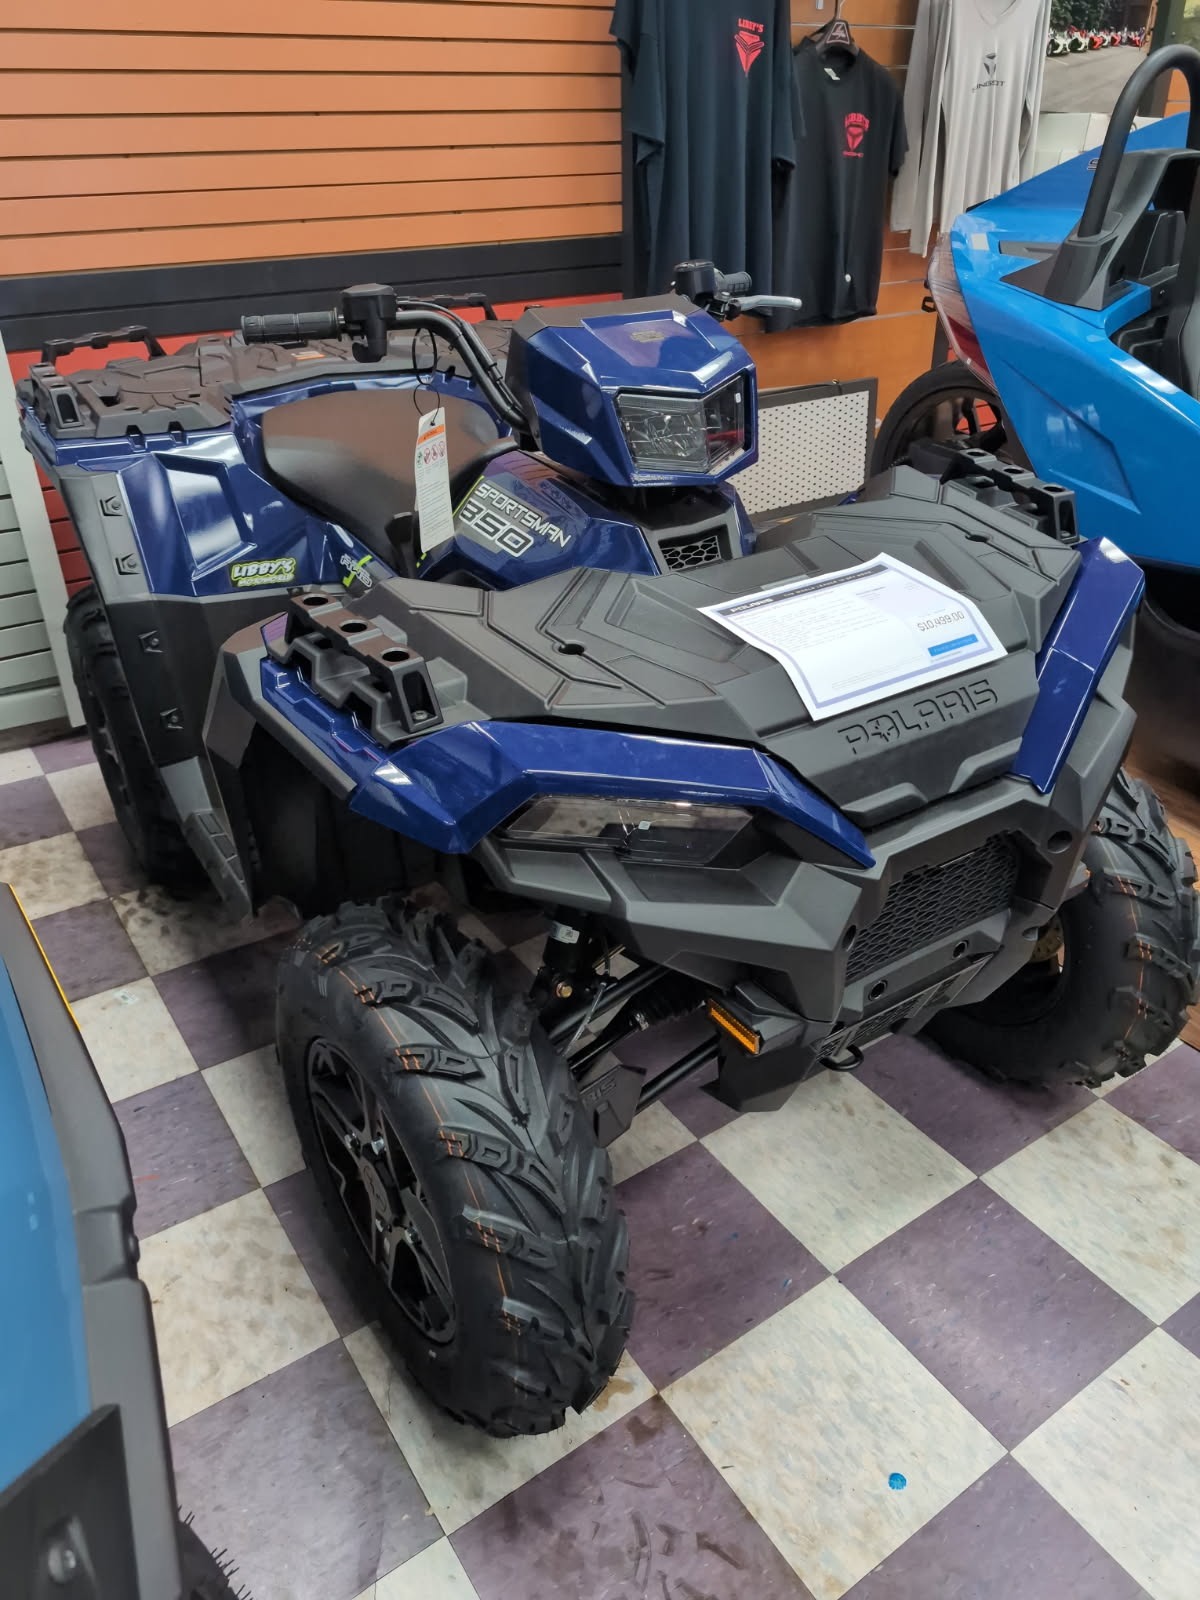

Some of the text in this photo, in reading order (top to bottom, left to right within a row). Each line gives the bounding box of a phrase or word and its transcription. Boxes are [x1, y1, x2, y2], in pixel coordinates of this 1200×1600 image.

[474, 483, 572, 548] SPORTSMAN
[233, 559, 293, 578] LIBBY'S
[730, 598, 774, 613] POLARIS
[917, 610, 965, 632] $10,499.00
[837, 679, 998, 755] POLARIS
